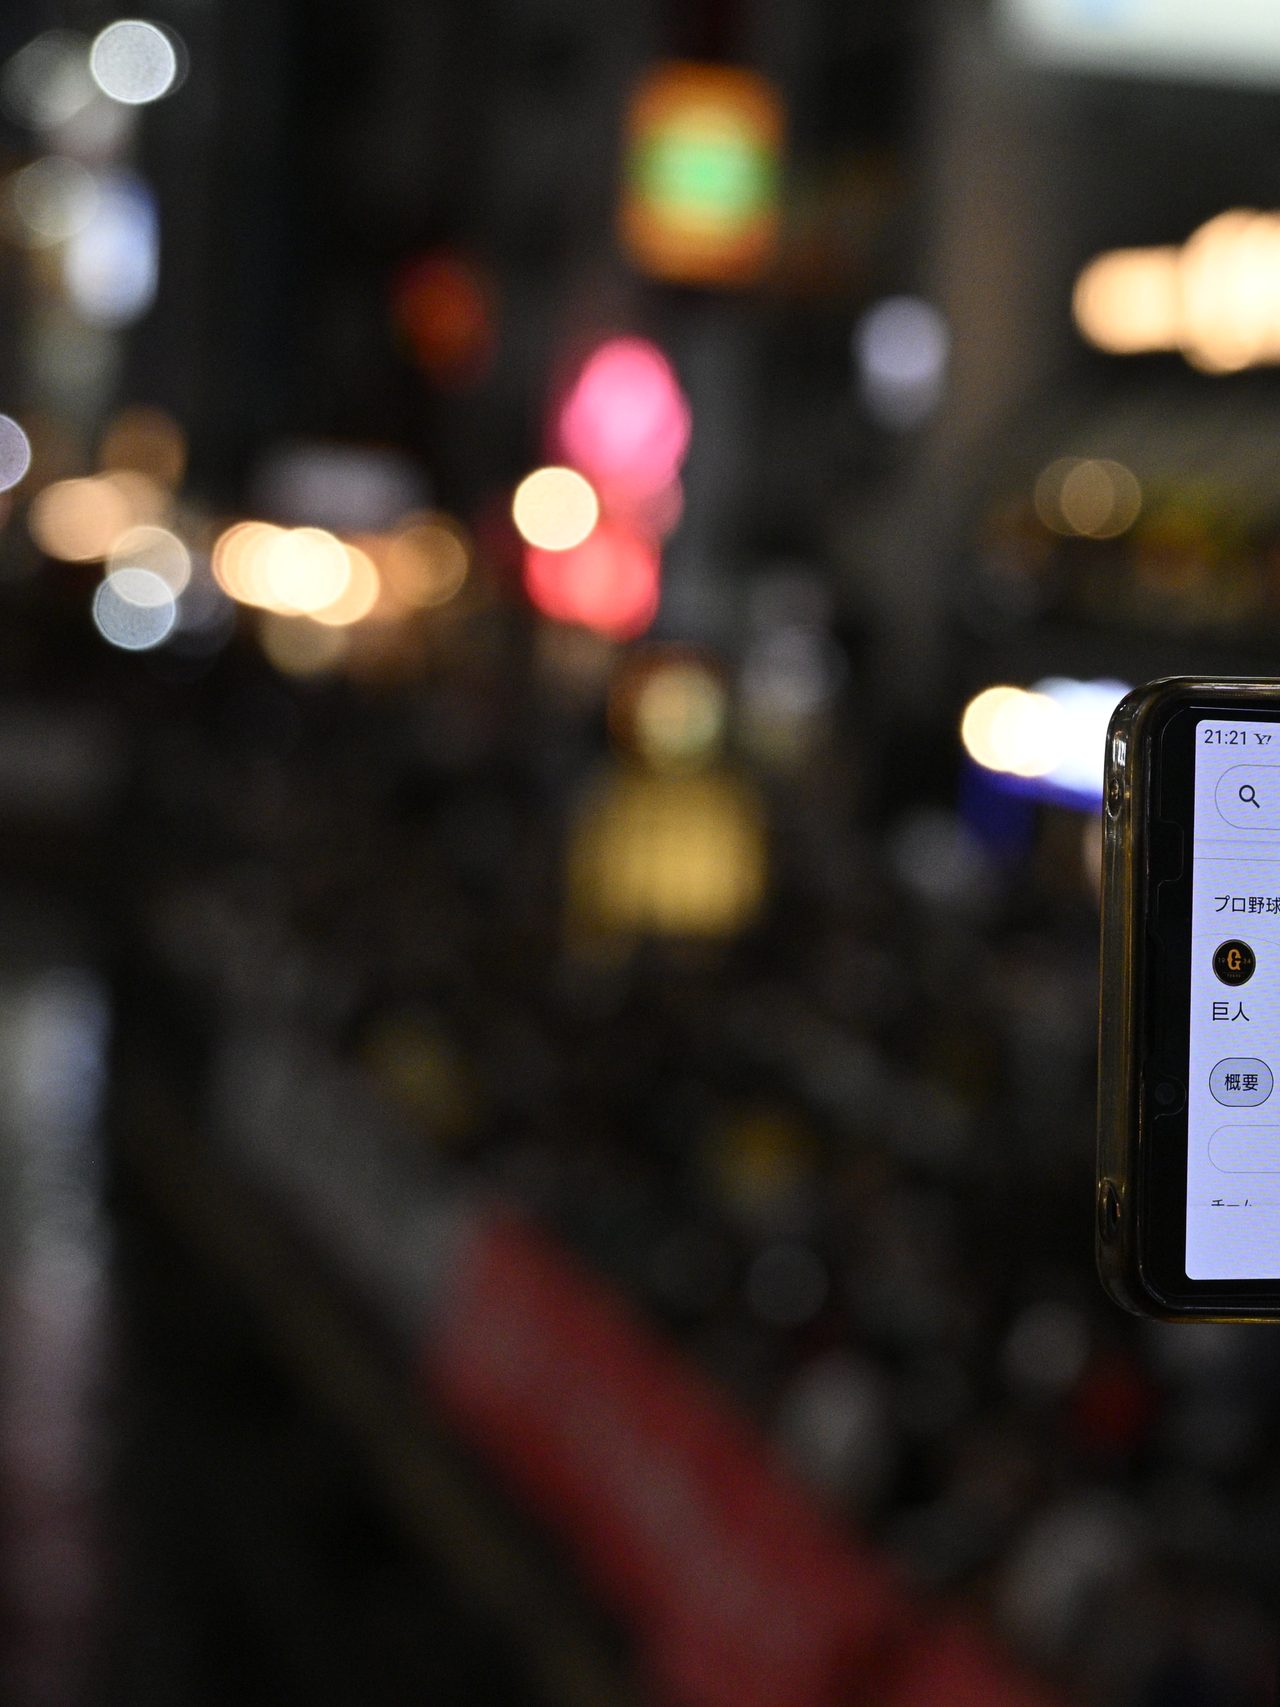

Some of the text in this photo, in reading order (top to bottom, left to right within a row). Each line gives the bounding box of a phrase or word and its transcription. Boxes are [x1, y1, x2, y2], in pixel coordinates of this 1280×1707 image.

[1204, 729, 1247, 745] 21:21
[1211, 1002, 1251, 1022] 巨人
[1223, 1073, 1259, 1092] 概要
